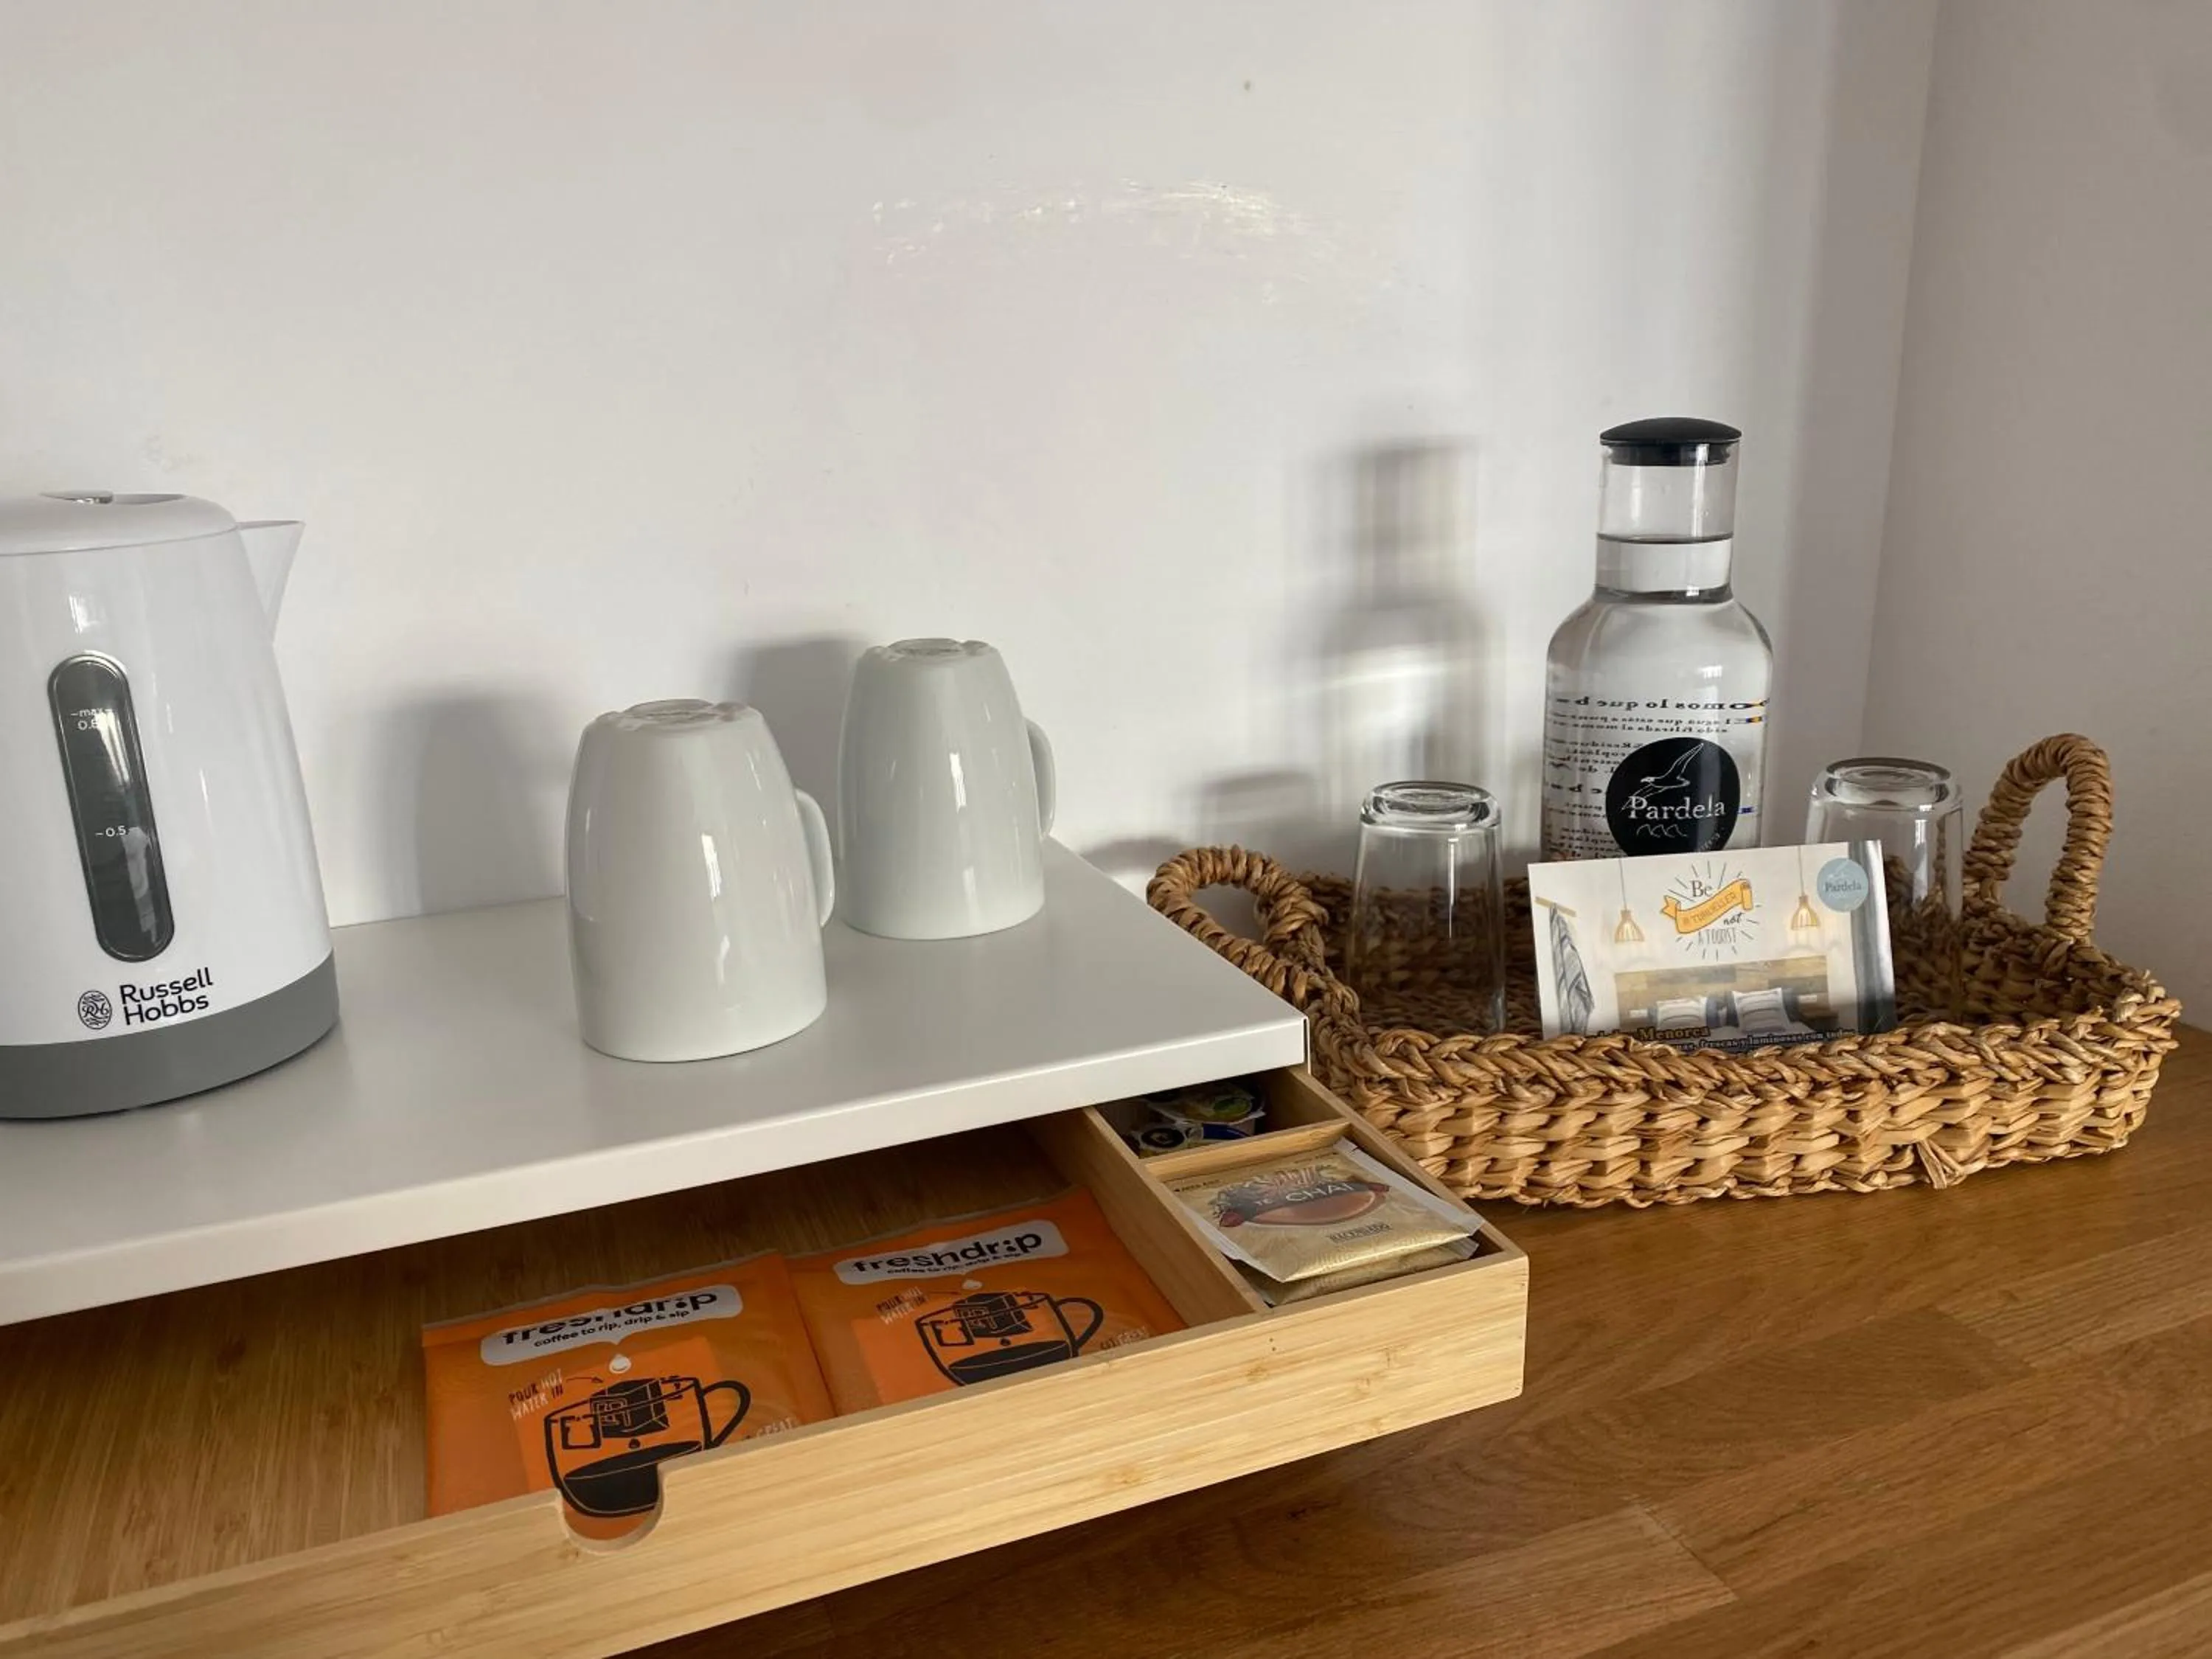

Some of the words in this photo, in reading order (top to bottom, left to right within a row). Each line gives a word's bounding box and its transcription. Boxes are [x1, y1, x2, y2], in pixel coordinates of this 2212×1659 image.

[1627, 794, 1726, 821] Pardela
[105, 825, 127, 838] 0.5
[1691, 880, 1713, 897] Be
[119, 967, 214, 1005] Russell
[123, 994, 209, 1026] Hobbs
[1285, 1182, 1355, 1203] CHAI
[852, 1233, 1042, 1272] freshdrip
[533, 1331, 579, 1348] coffee
[581, 1326, 597, 1335] to
[624, 1315, 653, 1326] drip
